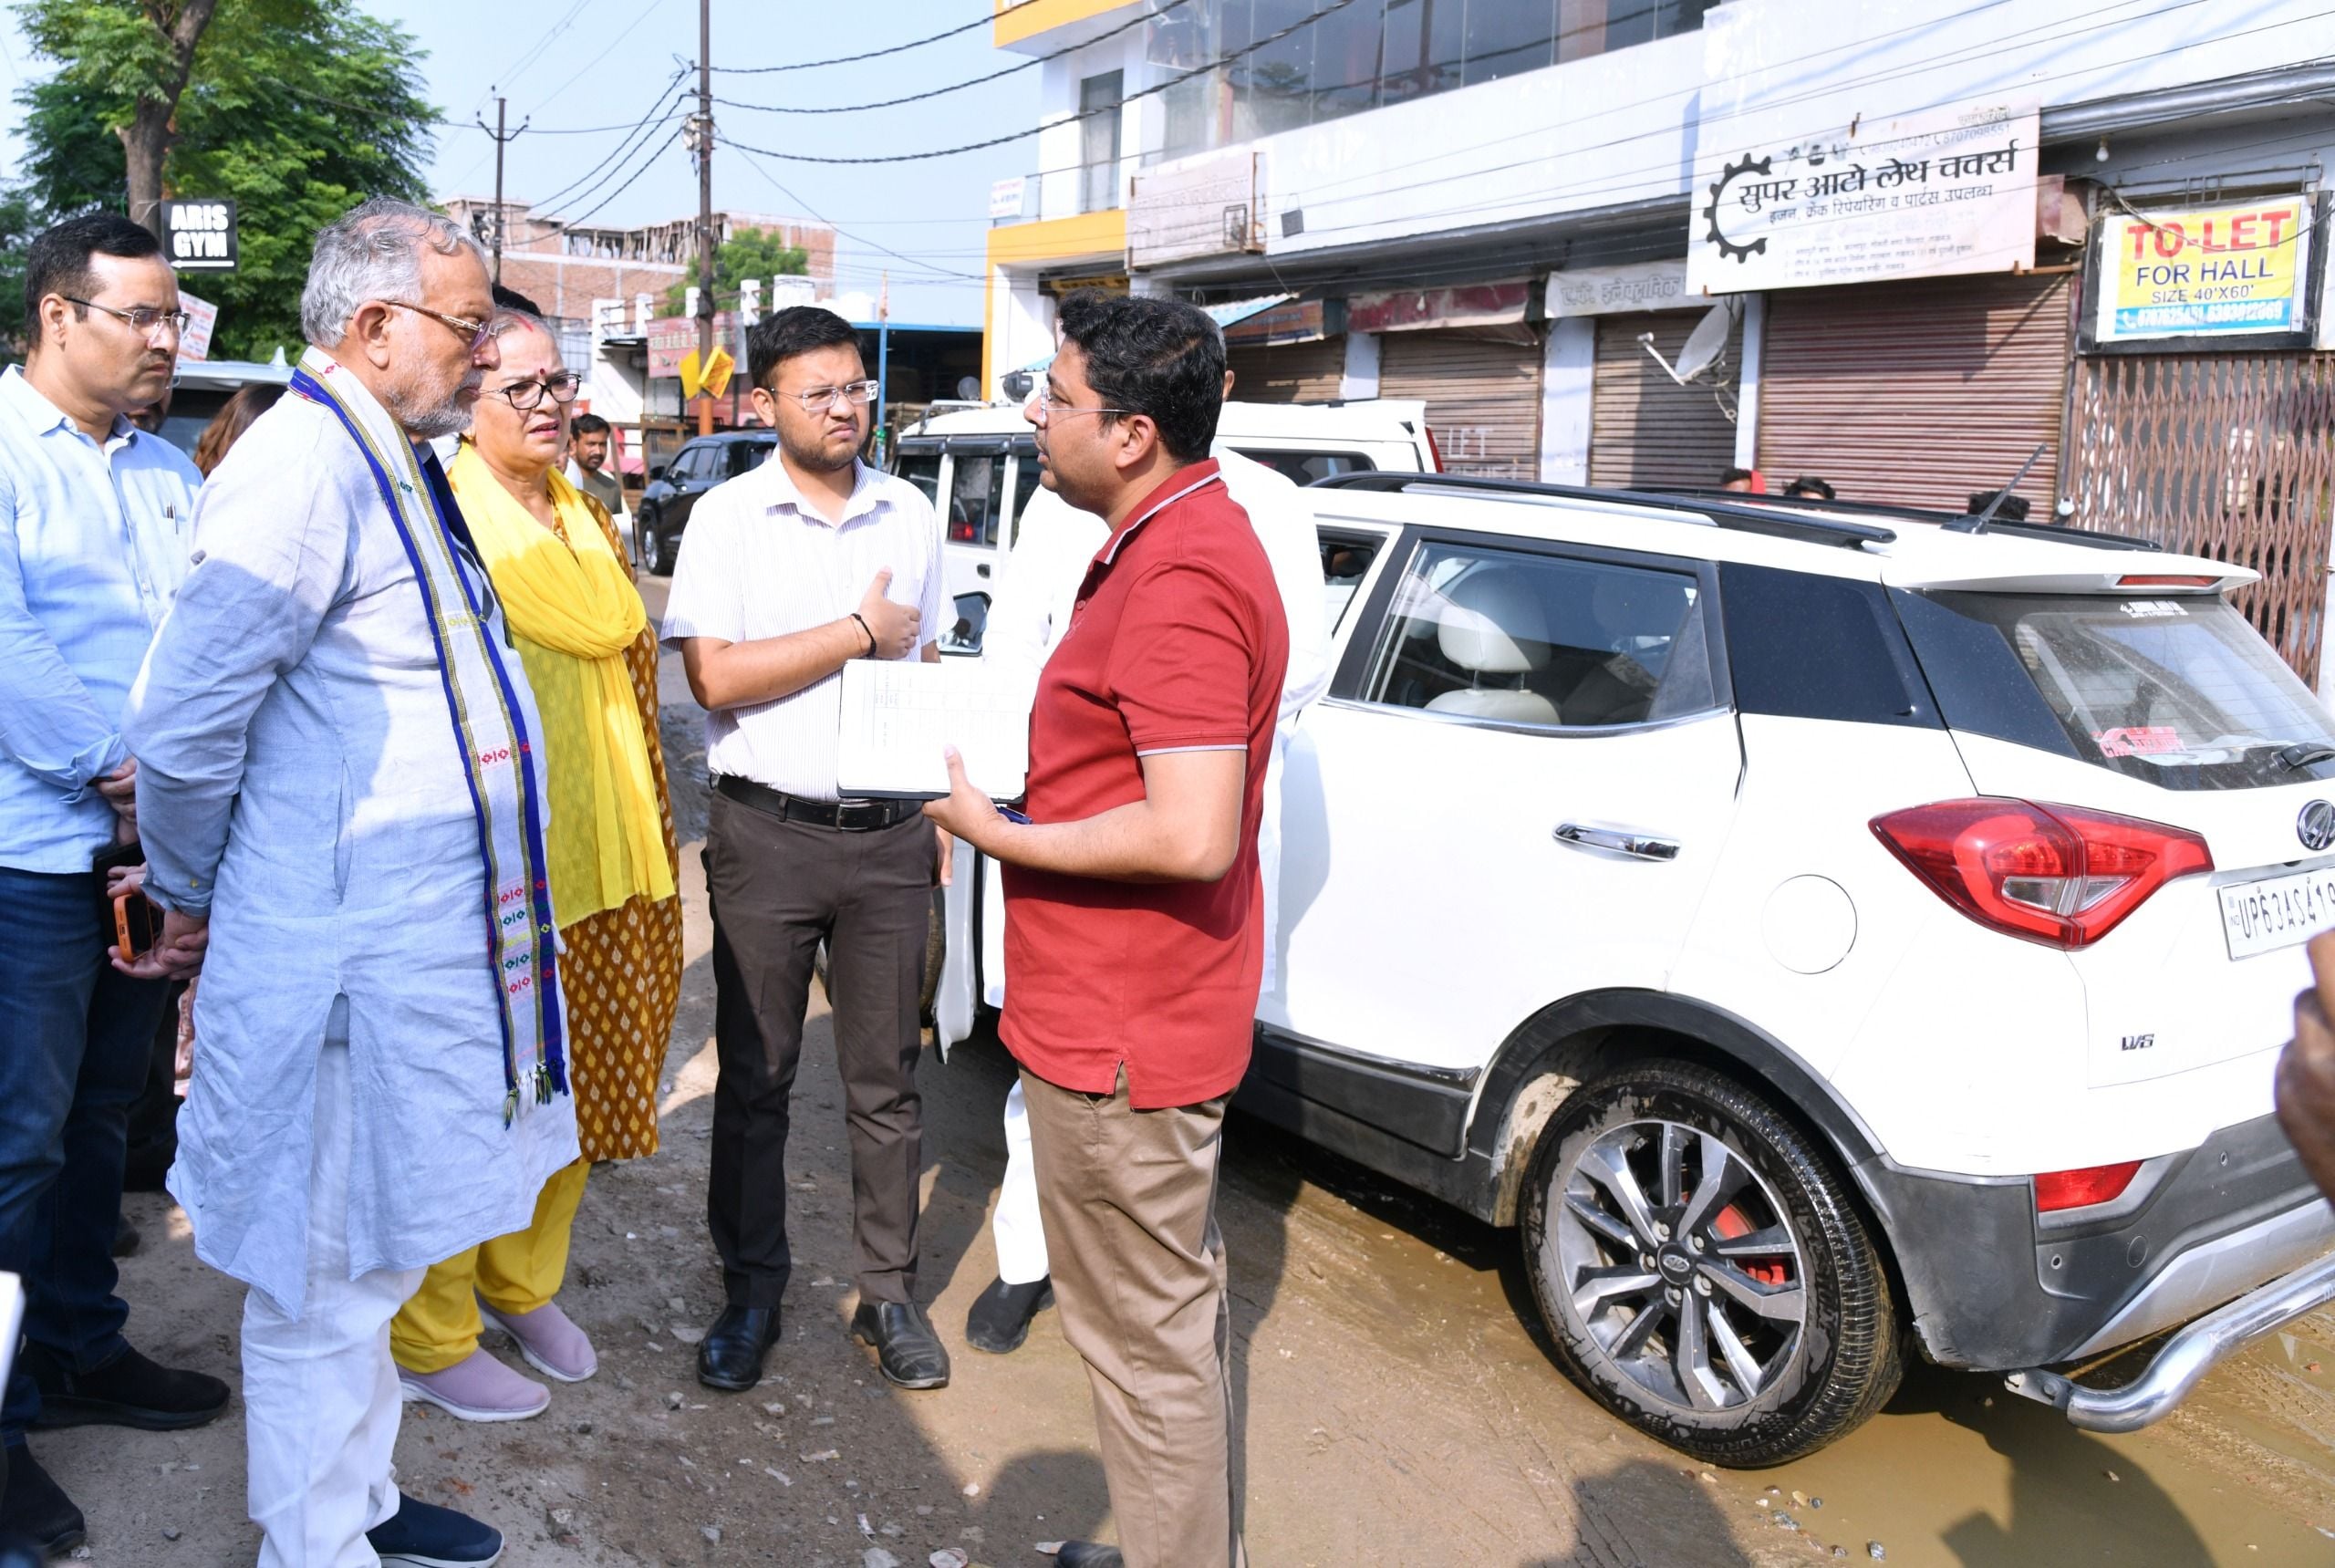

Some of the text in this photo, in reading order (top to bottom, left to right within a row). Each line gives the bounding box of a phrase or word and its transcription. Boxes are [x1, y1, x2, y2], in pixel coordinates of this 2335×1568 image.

[1739, 179, 1798, 213] सुपर
[1805, 163, 1866, 197] आटो
[1876, 159, 1930, 188] लेथ
[1891, 196, 1899, 207] व
[171, 204, 229, 231] ARIS
[172, 232, 228, 258] GYM
[2127, 211, 2291, 259] TO-LET
[2136, 259, 2274, 286] FOR HALL
[2152, 288, 2188, 305] SIZE
[1448, 427, 1493, 459] LET
